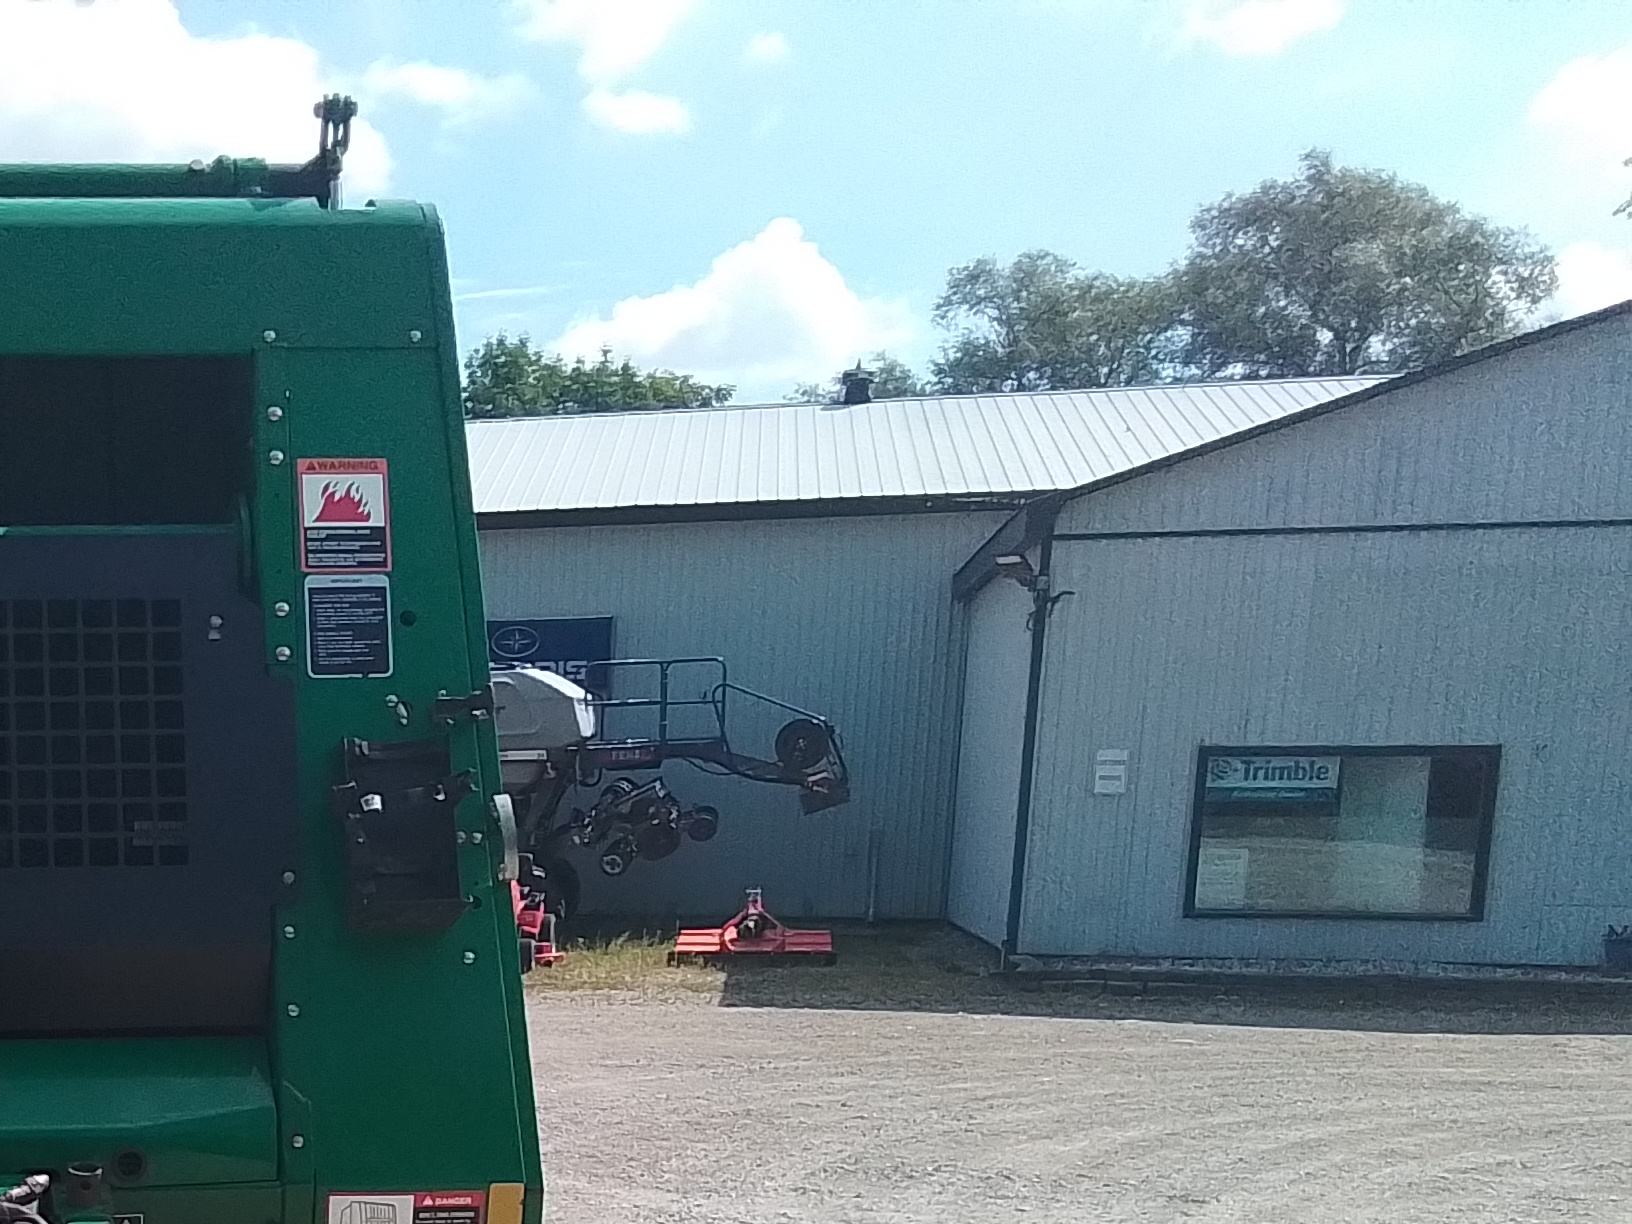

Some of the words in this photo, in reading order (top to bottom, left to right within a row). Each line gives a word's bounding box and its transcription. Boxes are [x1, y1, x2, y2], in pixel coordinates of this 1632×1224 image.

[317, 460, 378, 471] WARNING
[1240, 759, 1330, 782] Trimble
[435, 1196, 472, 1205] DANGER
